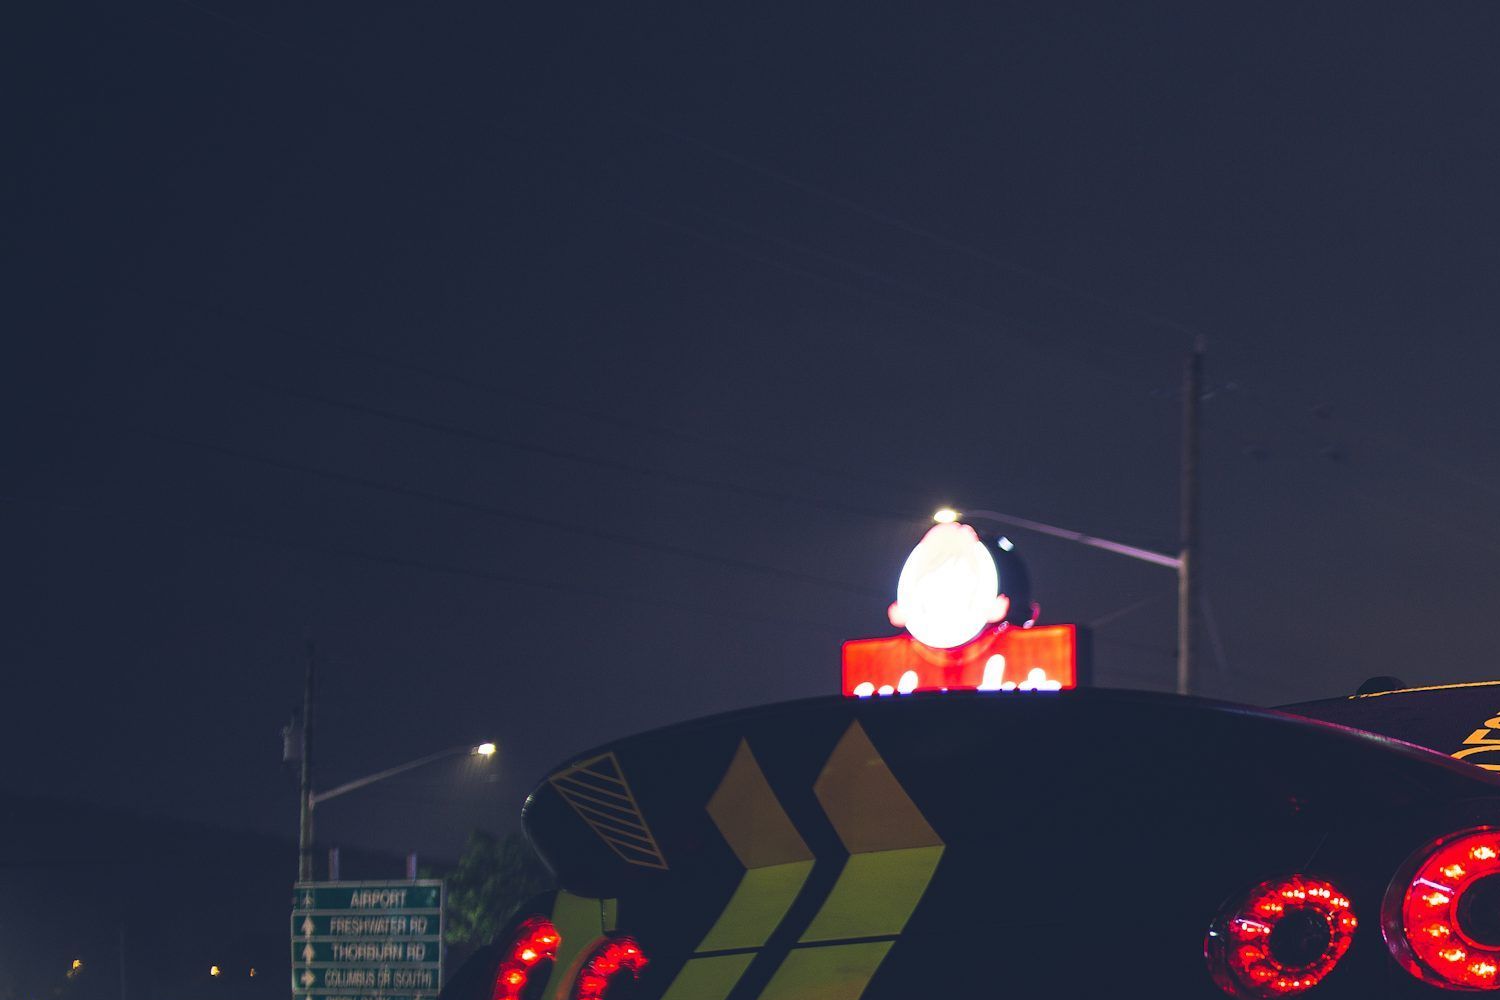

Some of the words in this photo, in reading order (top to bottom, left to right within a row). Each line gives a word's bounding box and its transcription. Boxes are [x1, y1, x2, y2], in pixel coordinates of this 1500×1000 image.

[350, 890, 407, 908] AIRPORT
[330, 917, 406, 935] FRESHWATER
[410, 916, 427, 933] RD
[332, 944, 402, 962] THORBURN
[407, 944, 425, 961] RD
[325, 970, 375, 988] COLUMBUS
[393, 970, 432, 988] (SOUTH)
